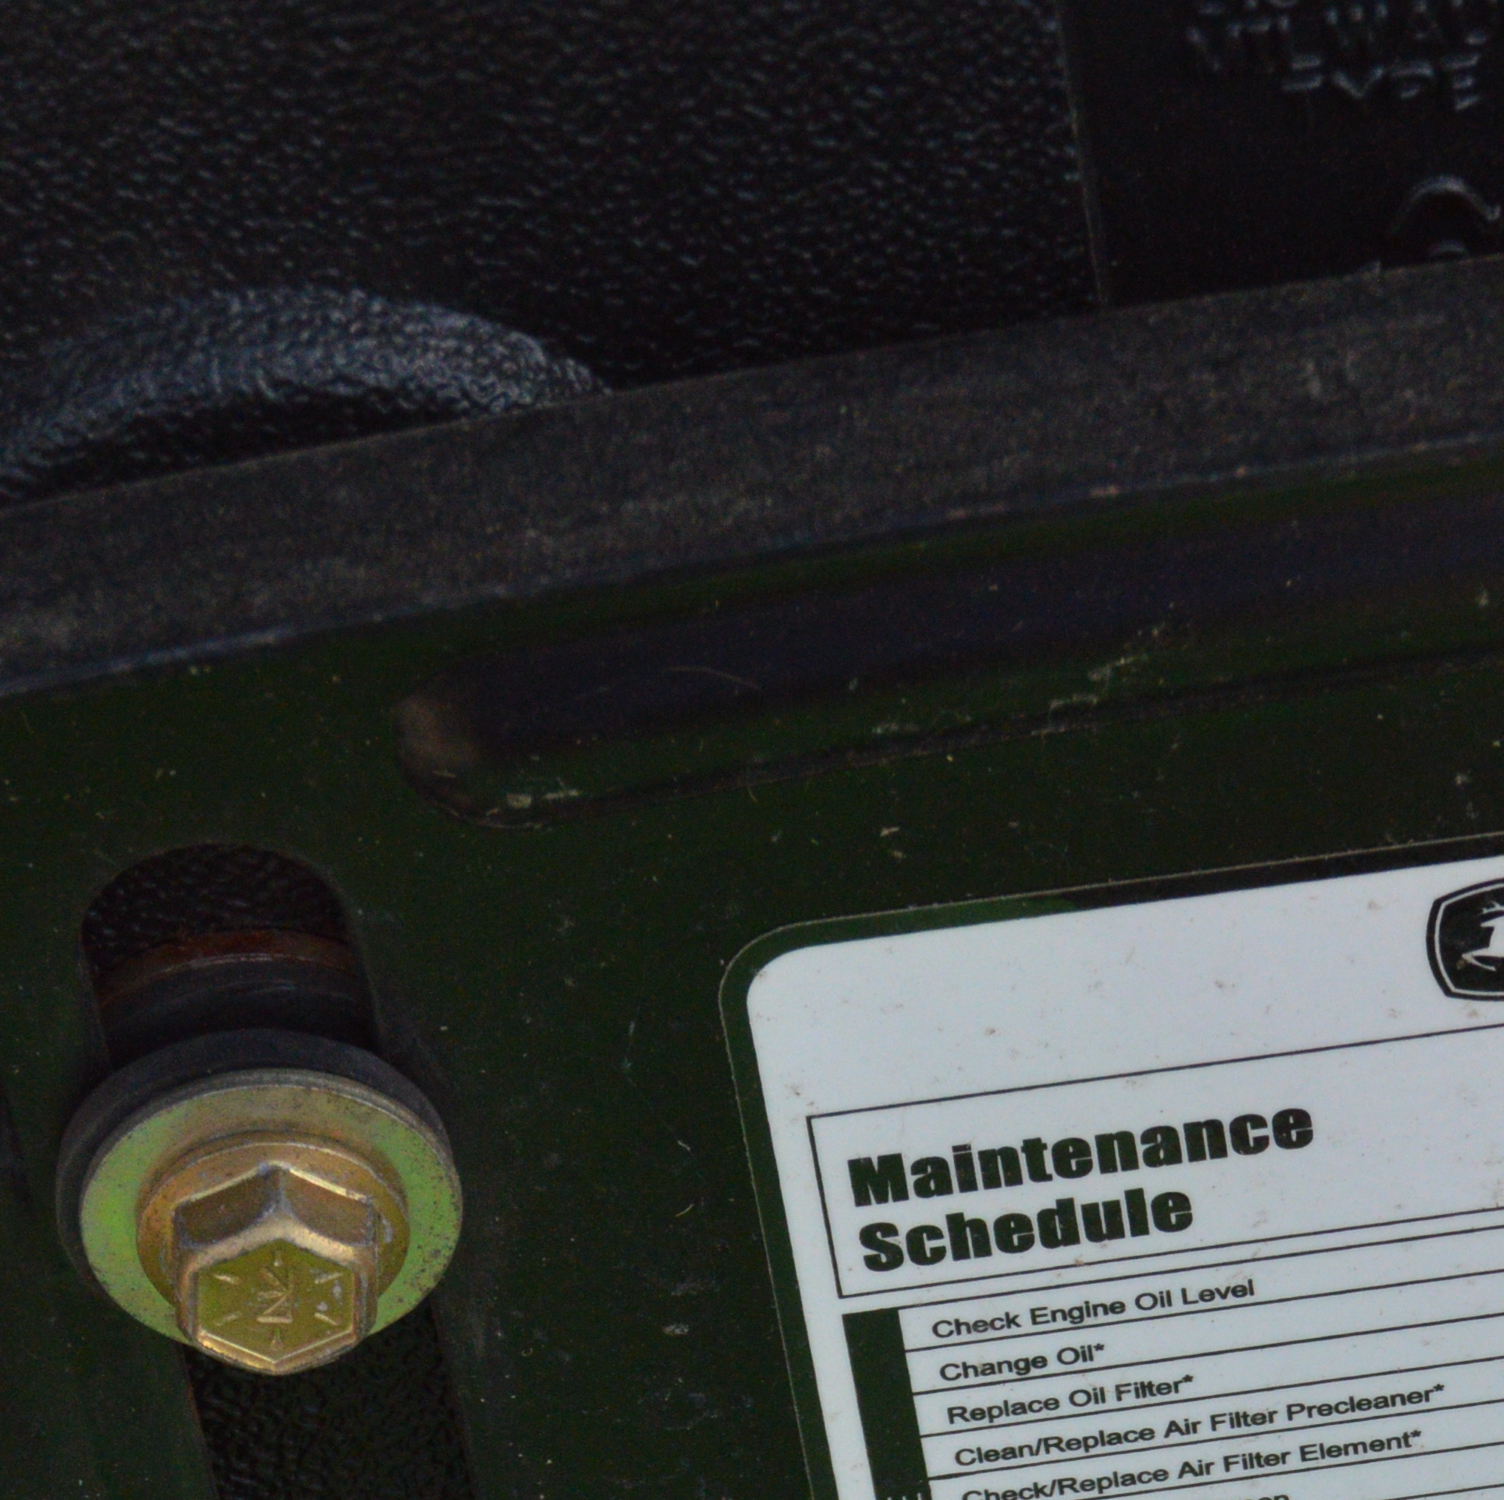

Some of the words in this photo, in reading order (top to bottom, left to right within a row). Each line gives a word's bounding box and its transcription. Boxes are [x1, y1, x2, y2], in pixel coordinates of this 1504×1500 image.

[846, 1107, 1314, 1207] Maintenance
[858, 1186, 1193, 1272] Schedule
[930, 1310, 1022, 1339] Check
[1028, 1299, 1126, 1326] Engine
[1133, 1288, 1173, 1311] Oil
[1179, 1277, 1255, 1306] Level
[938, 1354, 1048, 1382] Change
[946, 1396, 1060, 1425] Replace
[1067, 1385, 1107, 1408] Oil
[953, 1426, 1156, 1466] Clean/Replace
[1162, 1417, 1202, 1439] Air
[1208, 1409, 1279, 1432] Filter
[1176, 1458, 1215, 1480] Air
[1221, 1450, 1291, 1473] Filter
